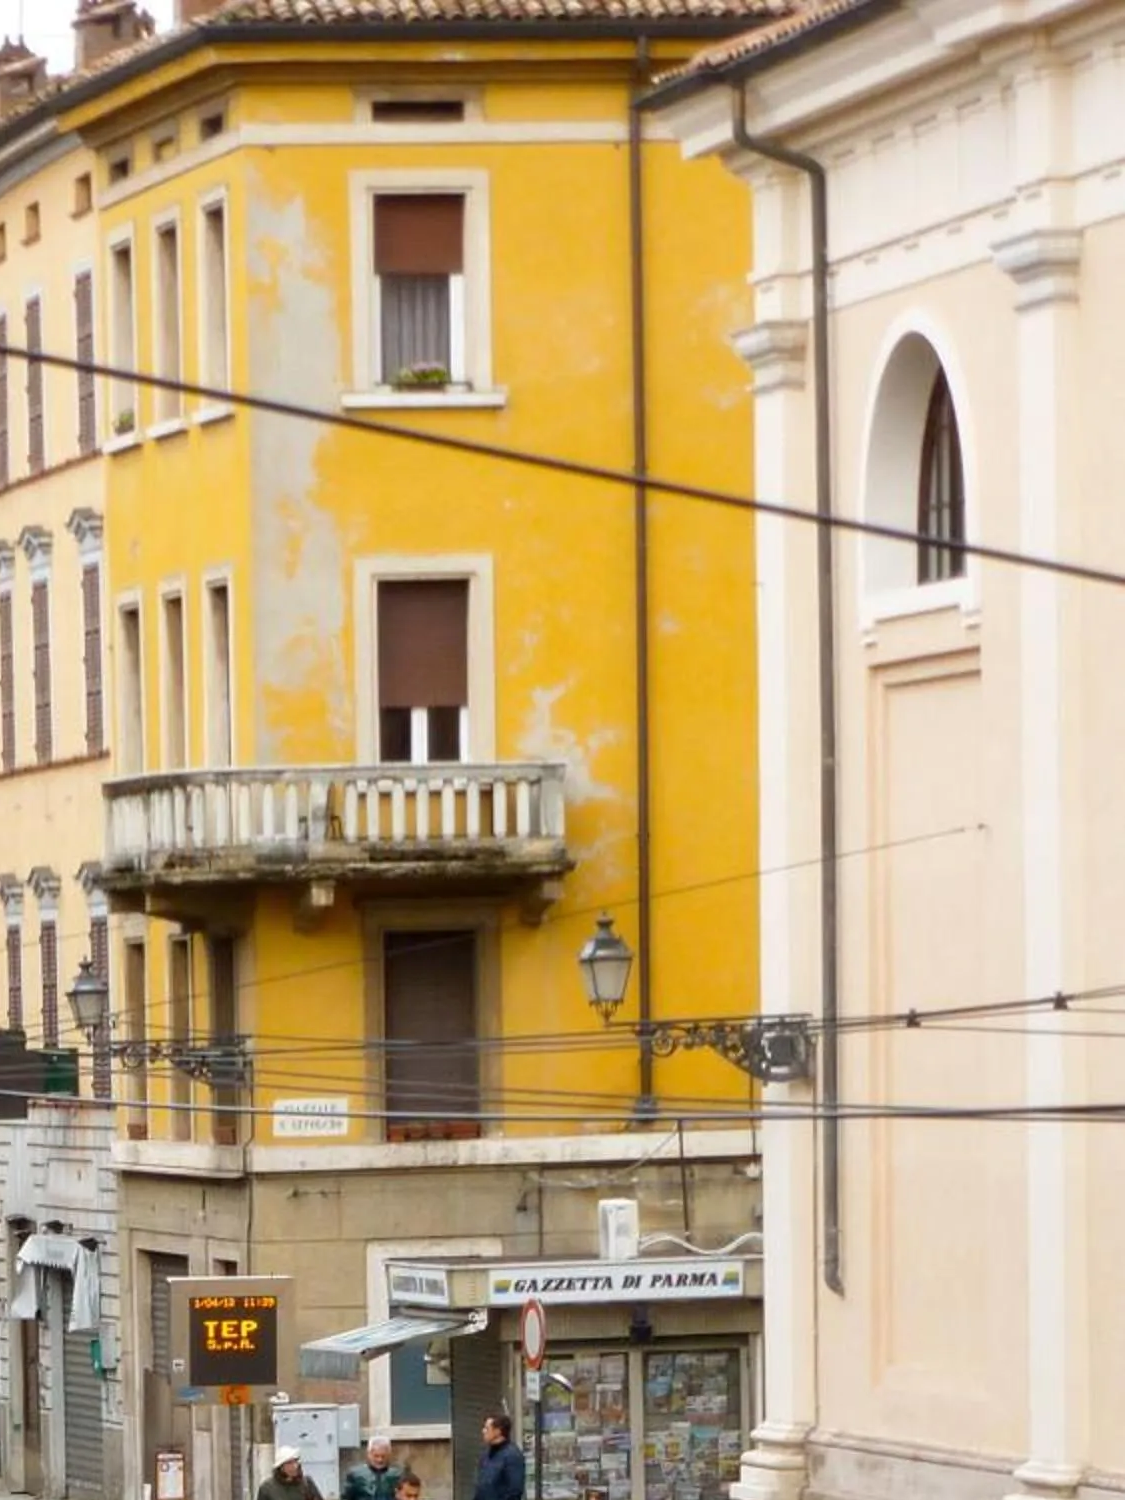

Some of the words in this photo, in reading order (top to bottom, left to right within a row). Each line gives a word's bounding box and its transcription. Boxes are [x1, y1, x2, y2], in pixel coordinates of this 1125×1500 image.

[513, 1274, 614, 1294] GAZZETTA
[621, 1273, 641, 1290] DI
[649, 1271, 719, 1289] PARMA
[203, 1319, 259, 1338] TEP
